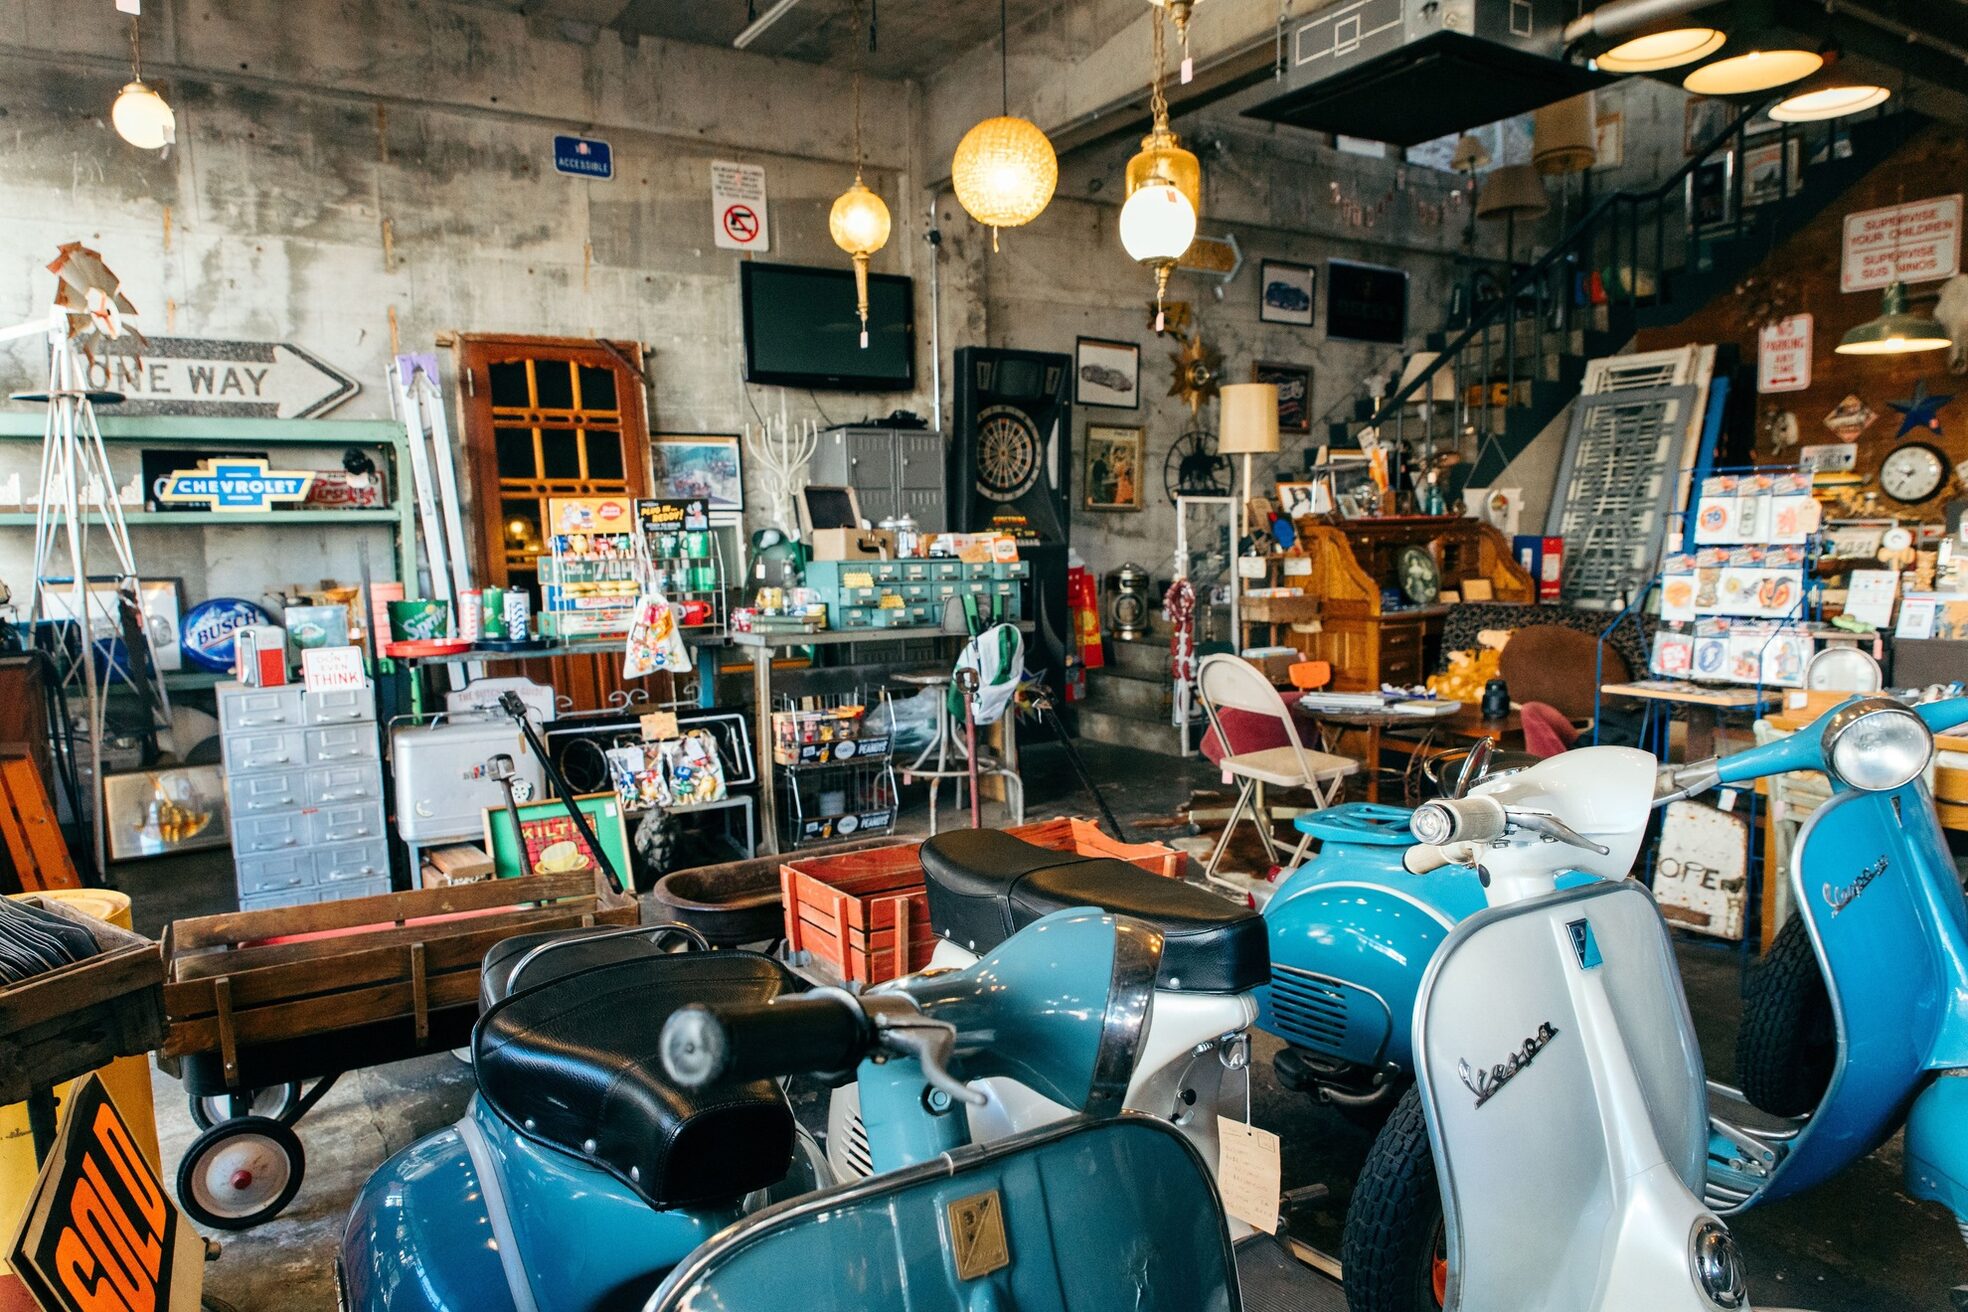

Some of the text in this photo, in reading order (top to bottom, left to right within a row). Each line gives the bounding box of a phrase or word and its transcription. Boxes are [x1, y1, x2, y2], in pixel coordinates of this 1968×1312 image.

[558, 157, 609, 174] ACCESSIBLE
[1864, 209, 1937, 230] SUPERVISE
[1851, 220, 1953, 245] YOUR CHILDREN
[1863, 246, 1936, 266] SUPERVISE
[1764, 336, 1804, 352] PARKING
[86, 361, 268, 397] ONE WAY
[177, 479, 298, 495] CHEVROLET
[198, 611, 258, 646] BUSCH
[311, 671, 360, 687] THINK
[857, 741, 888, 755] PEANUTS
[860, 815, 890, 829] PEANUTS
[1458, 1021, 1559, 1111] Vespa
[55, 1102, 168, 1312] SOLD
